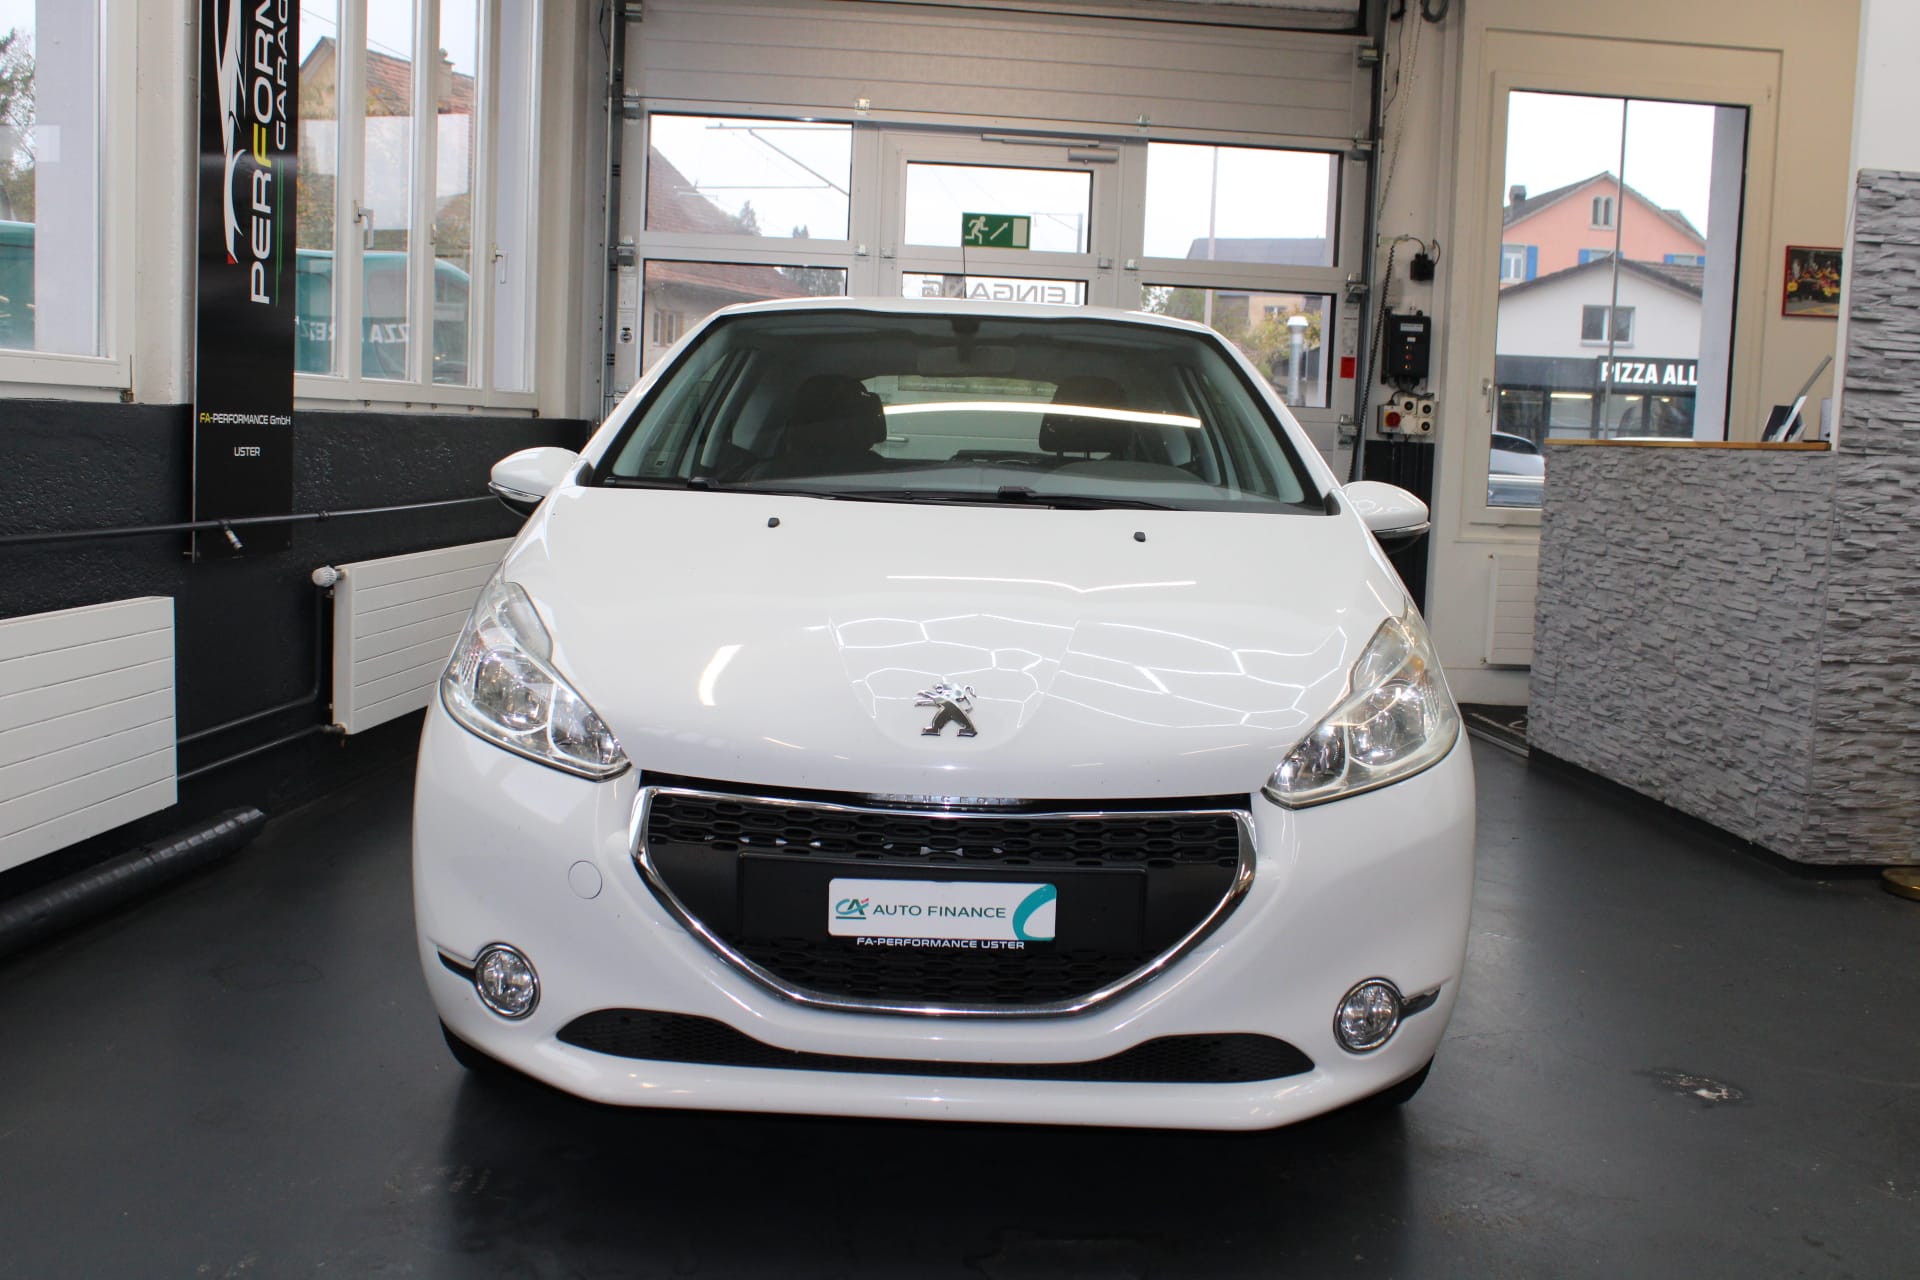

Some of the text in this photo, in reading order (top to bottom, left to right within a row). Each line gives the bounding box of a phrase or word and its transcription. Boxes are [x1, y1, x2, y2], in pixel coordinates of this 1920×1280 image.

[1601, 361, 1658, 384] PIZZA
[200, 413, 291, 425] FA-PERFORMANCE GmbH
[234, 446, 261, 457] USTER
[873, 904, 922, 916] AUTO
[928, 905, 1006, 918] FINANCE
[857, 937, 1025, 950] FA-PERFORMANCE USTER
